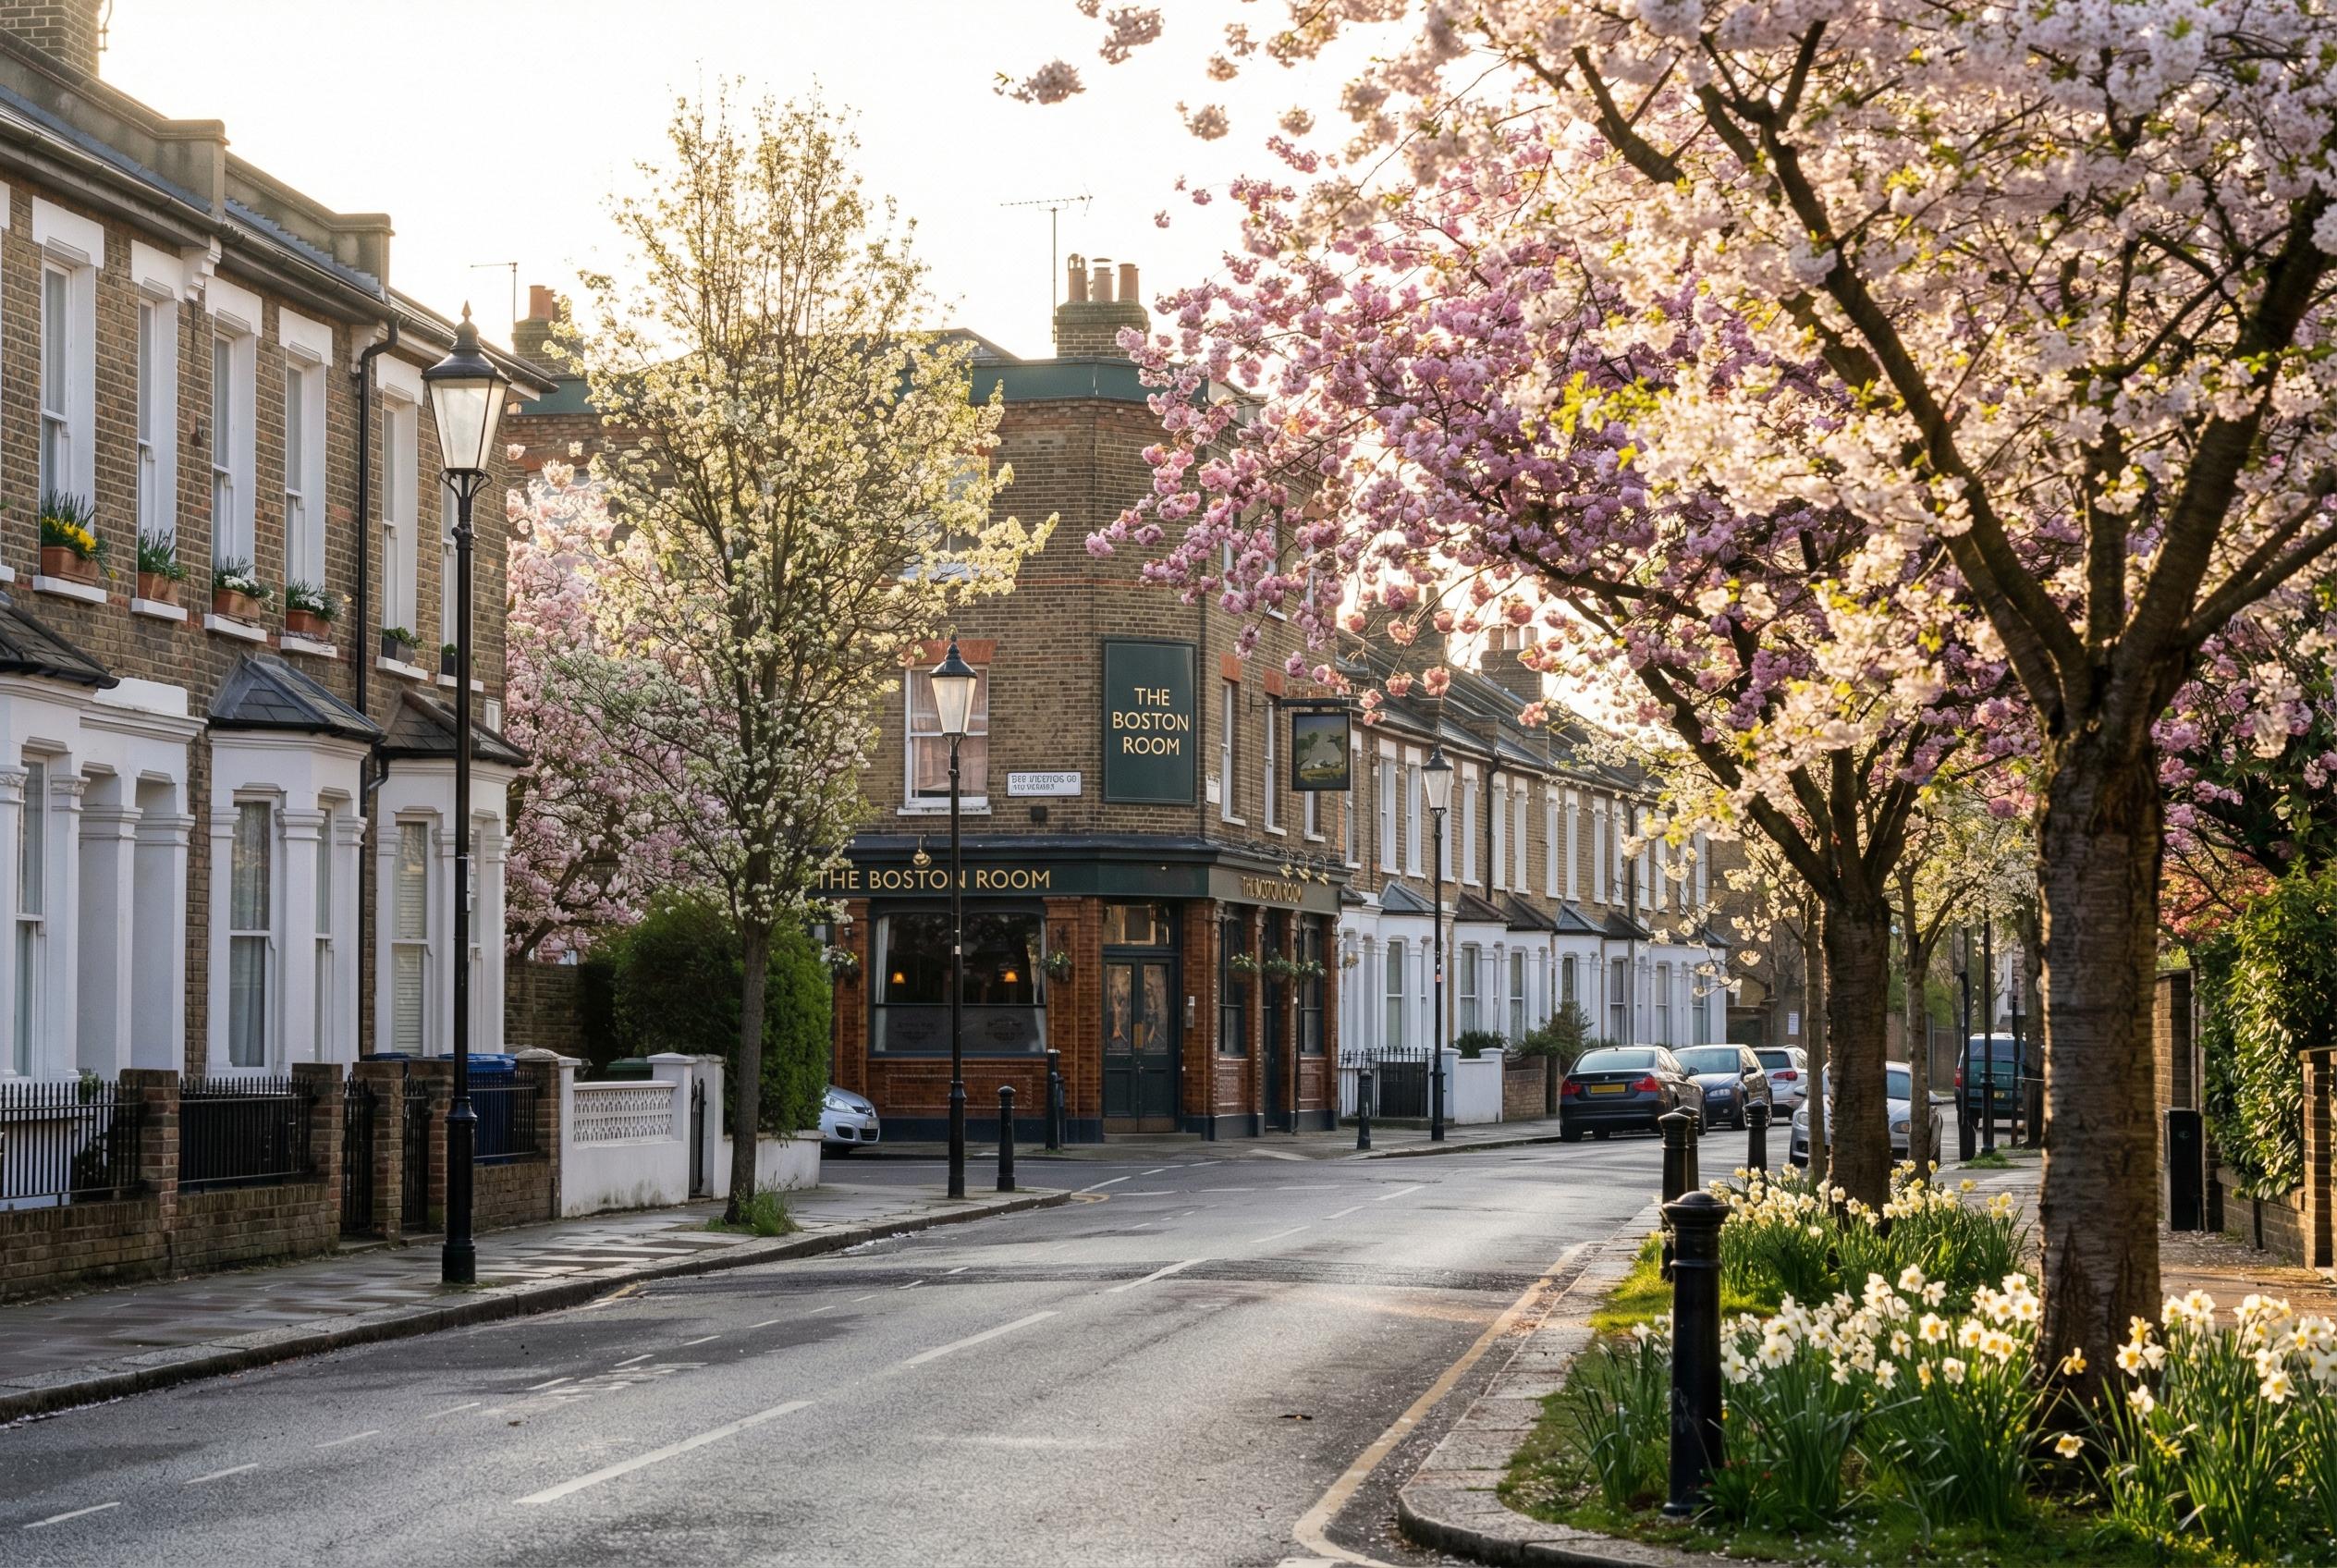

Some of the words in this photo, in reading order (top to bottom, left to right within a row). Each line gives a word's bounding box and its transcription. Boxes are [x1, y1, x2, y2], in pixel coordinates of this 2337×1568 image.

[1134, 687, 1170, 706] THE
[1112, 711, 1189, 731] BOSTON
[1123, 736, 1180, 755] ROOM
[816, 870, 861, 889] THE
[976, 869, 1051, 889] ROOM
